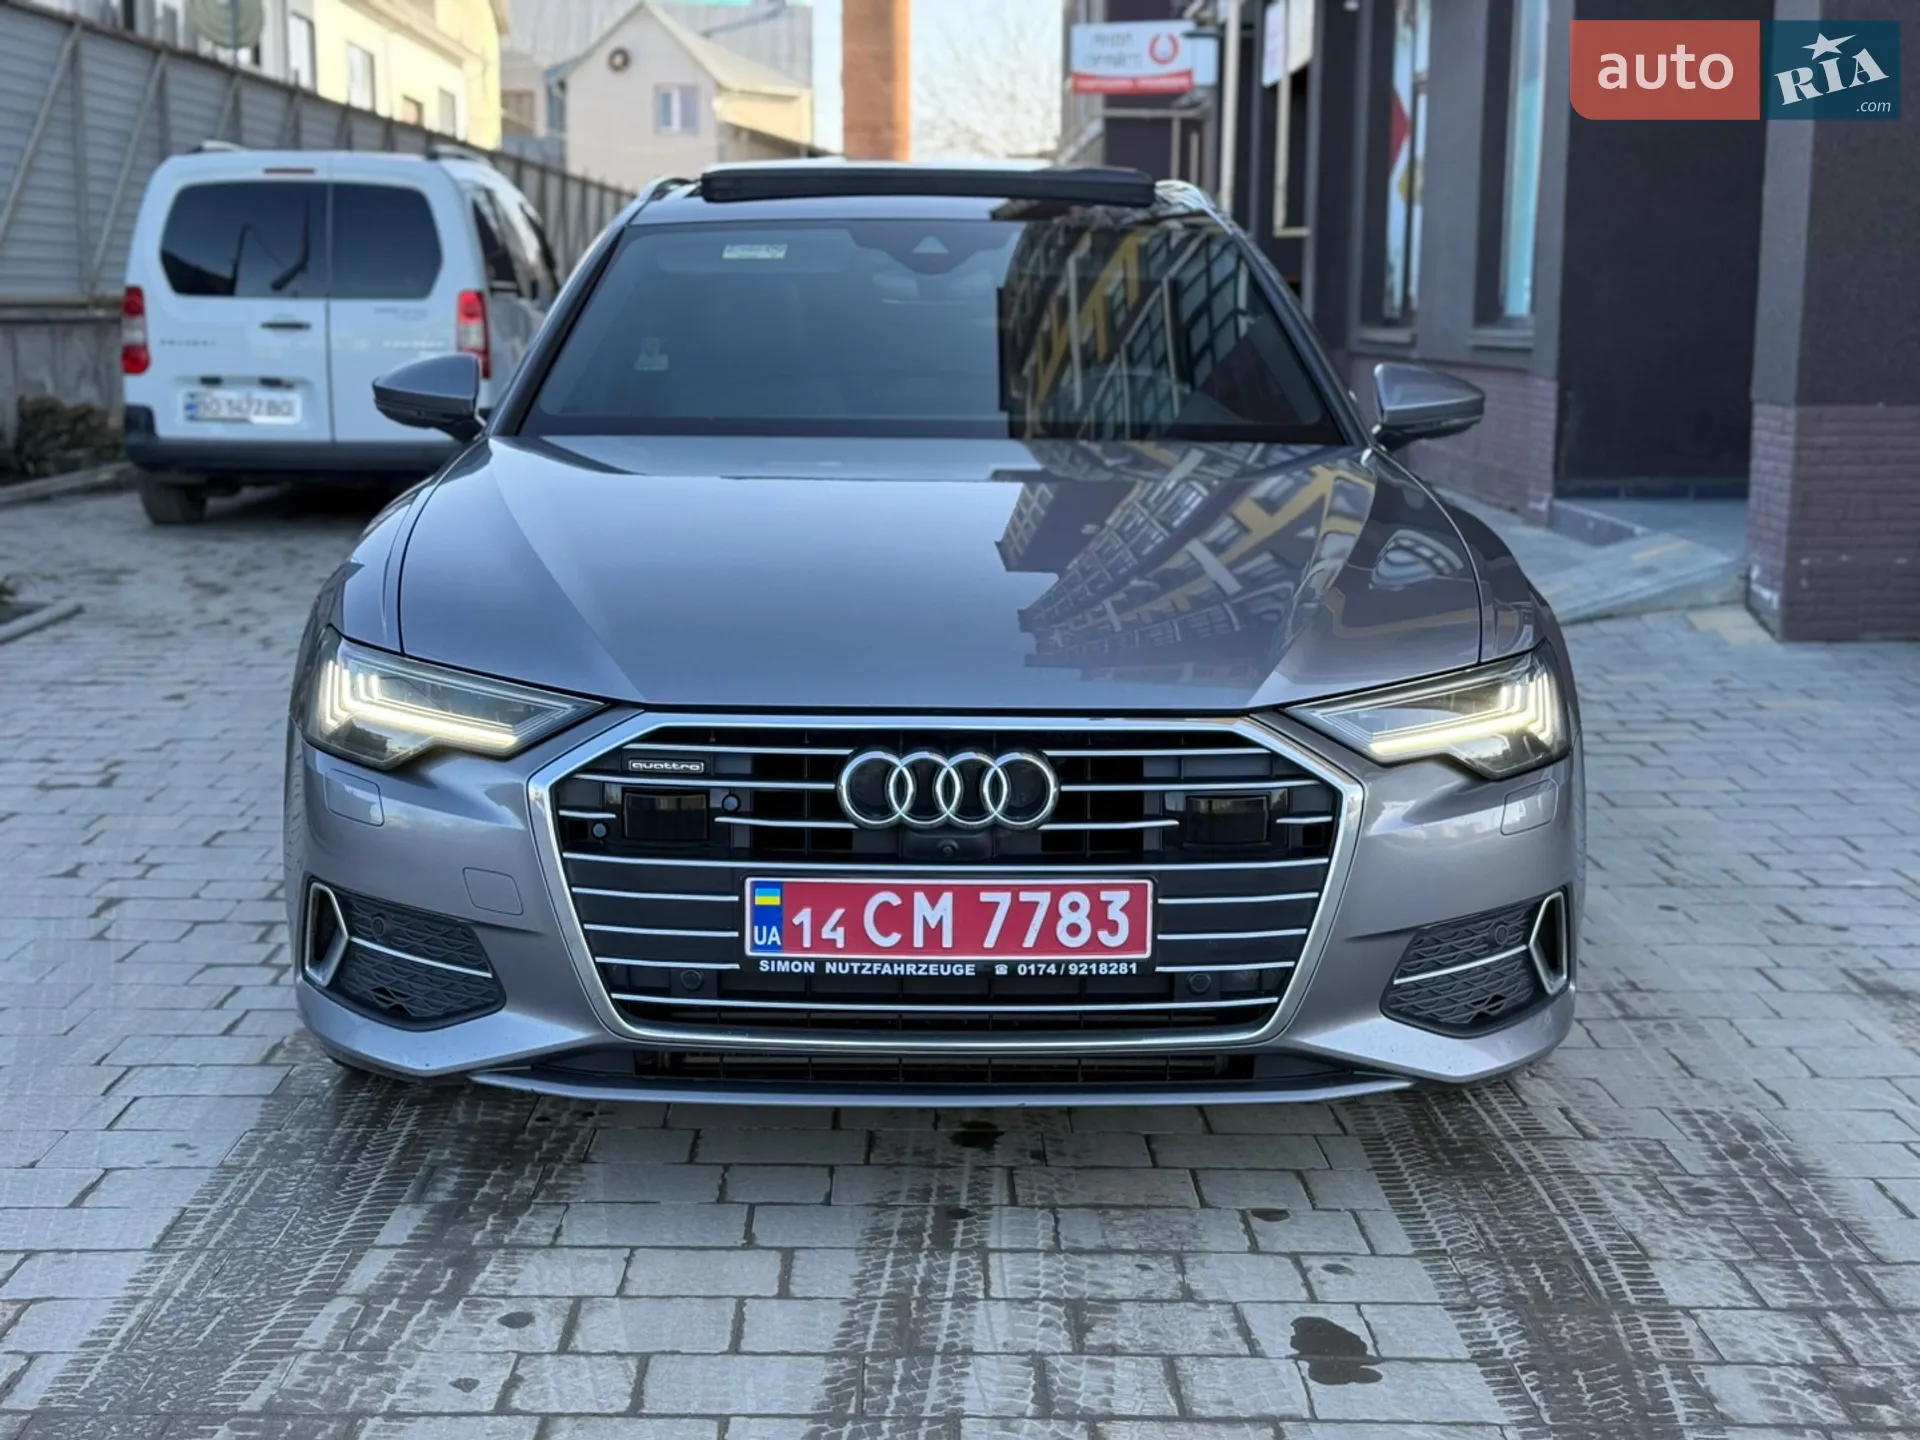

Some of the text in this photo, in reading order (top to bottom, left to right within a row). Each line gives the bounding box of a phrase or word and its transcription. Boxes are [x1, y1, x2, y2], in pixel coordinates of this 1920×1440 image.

[632, 762, 700, 771] quattro
[791, 890, 1130, 949] 14 CM 7783
[753, 925, 782, 946] UA
[758, 959, 815, 973] SIMON
[825, 961, 976, 976] NUTZFAHRZEUGE
